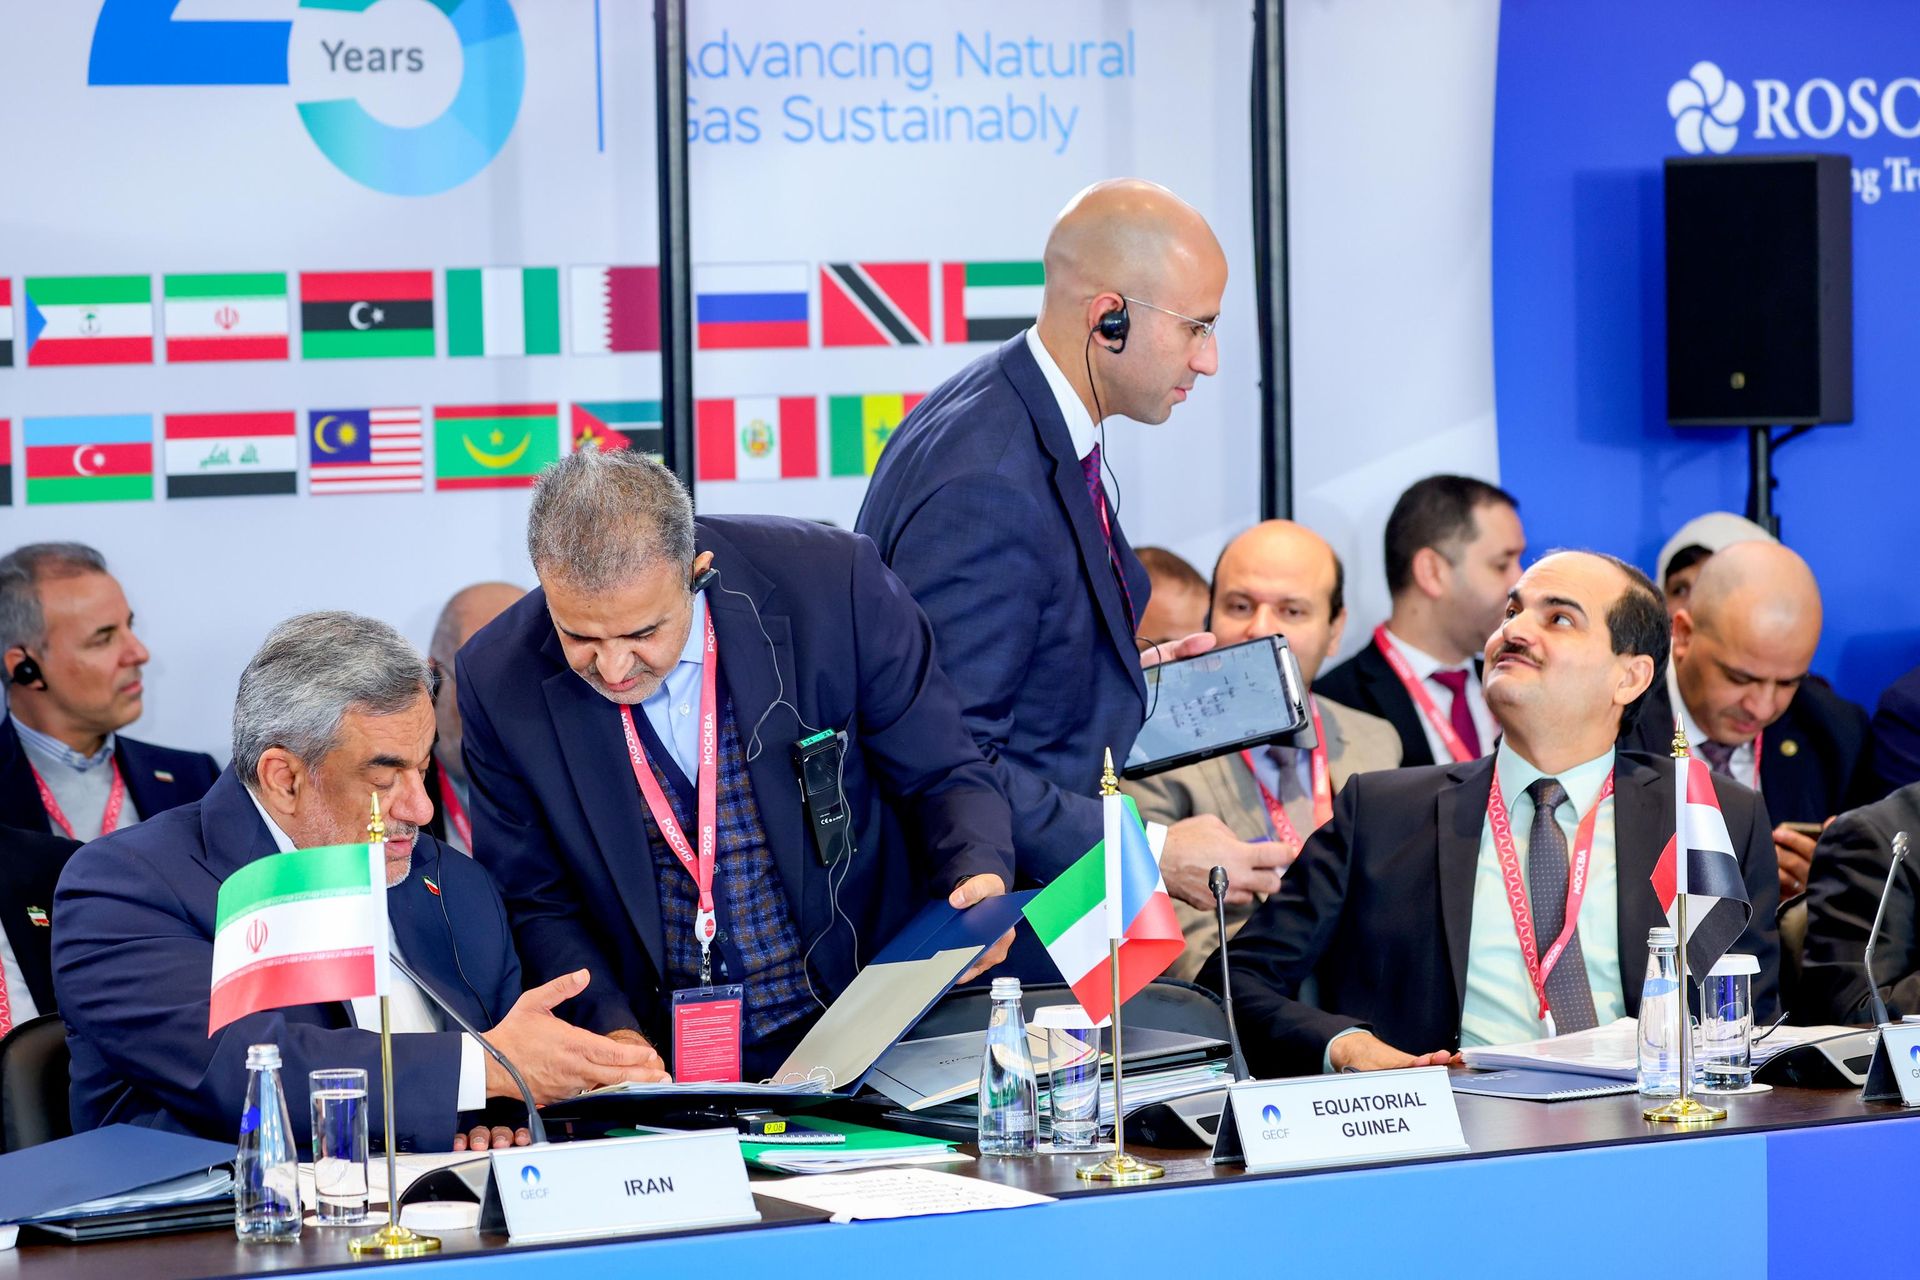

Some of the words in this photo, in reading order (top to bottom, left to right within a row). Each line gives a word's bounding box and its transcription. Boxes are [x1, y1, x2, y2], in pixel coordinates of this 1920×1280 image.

[320, 39, 424, 72] Years
[956, 28, 1135, 78] Natural
[782, 92, 1079, 156] Sustainably
[1752, 77, 1920, 139] ROSC
[1883, 156, 1920, 193] Tr
[620, 712, 643, 765] MOSCOW
[703, 712, 713, 765] МОСКВА
[662, 817, 693, 863] РОССИЯ
[703, 825, 712, 856] 2026
[1573, 848, 1588, 896] МОСКВА
[1312, 1091, 1427, 1117] EQUATORIAL
[1262, 1128, 1290, 1141] GECF
[1341, 1117, 1411, 1138] GUINEA
[520, 1187, 549, 1200] GECF
[624, 1176, 675, 1197] IRAN
